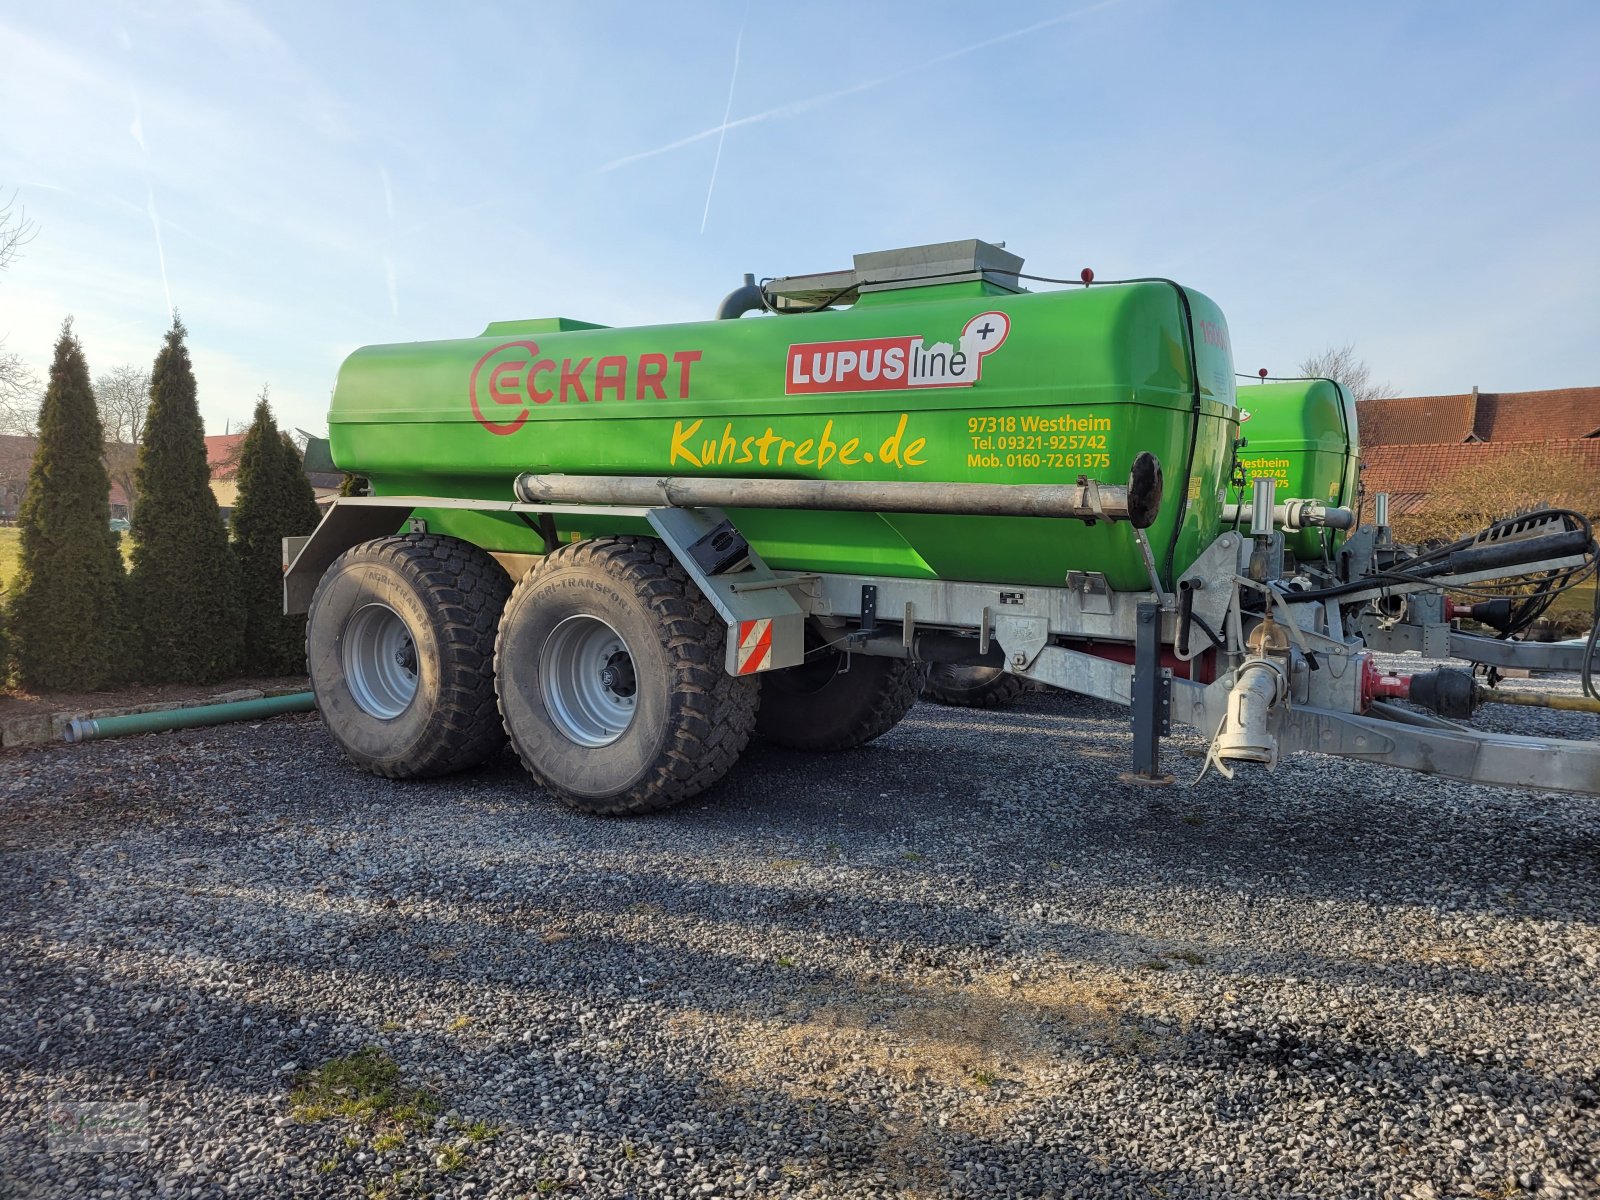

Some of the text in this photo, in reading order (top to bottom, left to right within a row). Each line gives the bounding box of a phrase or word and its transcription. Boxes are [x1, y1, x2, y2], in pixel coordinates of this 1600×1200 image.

[968, 414, 1112, 433] 97318 Westheim
[670, 414, 929, 470] Kuhstrebe.de
[967, 454, 1004, 468] Mob.
